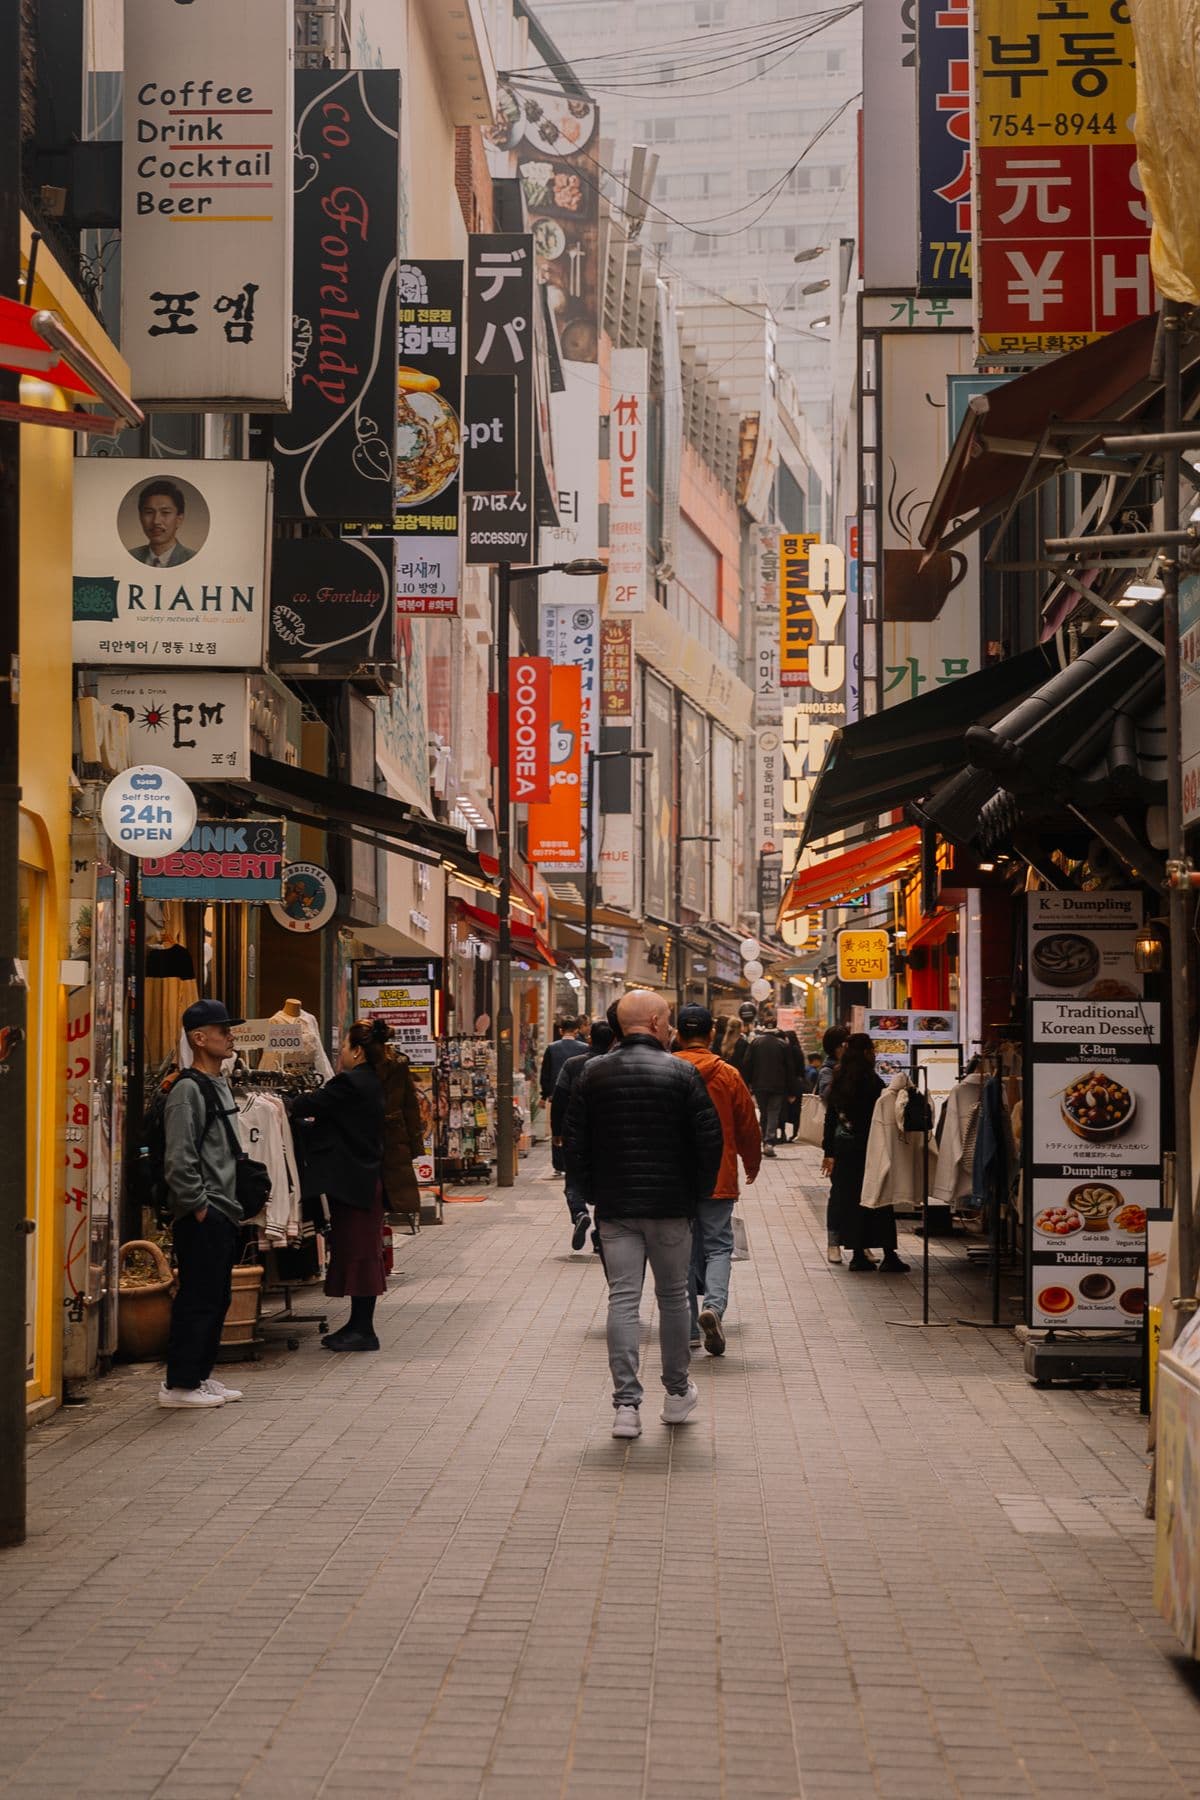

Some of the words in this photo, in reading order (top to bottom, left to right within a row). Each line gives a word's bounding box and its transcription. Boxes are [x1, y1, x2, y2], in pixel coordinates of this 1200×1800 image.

[982, 33, 1136, 98] 부동
[138, 81, 253, 106] Coffee
[137, 117, 223, 143] Drink
[988, 113, 1117, 137] 754-8944
[137, 152, 271, 178] Cocktail
[995, 160, 1072, 225] 元
[137, 192, 212, 215] Beer
[302, 186, 369, 405] Forelady
[148, 283, 259, 344] 포엠
[417, 309, 452, 323] 전문점
[889, 297, 955, 327] 가무
[398, 325, 456, 355] 화떡
[470, 530, 528, 548] accessory
[397, 562, 441, 579] 리새끼
[128, 584, 254, 612] RIAHN
[615, 586, 638, 602] 2F
[136, 614, 164, 625] variety
[166, 614, 200, 624] network
[99, 640, 148, 654] 리안헤어
[162, 641, 184, 654] 명동
[189, 641, 217, 655] 1호점
[608, 695, 625, 709] 3F
[516, 665, 537, 796] COCOREA
[122, 793, 141, 801] Self
[144, 793, 170, 801] Store
[120, 804, 172, 824] 24h
[120, 828, 172, 840] OPEN
[182, 826, 248, 852] INK
[254, 828, 279, 852] &
[142, 852, 281, 879] DESSERT
[1063, 898, 1132, 913] Dumpling
[1056, 1004, 1139, 1018] Traditional
[1041, 1022, 1096, 1036] Korean
[1099, 1022, 1155, 1036] Dessert
[270, 1037, 300, 1047] 0.000
[1080, 1044, 1116, 1055] K-Bun
[1062, 1165, 1118, 1179] Dumpling
[1116, 1240, 1131, 1248] Vegan
[1056, 1252, 1103, 1266] Pudding
